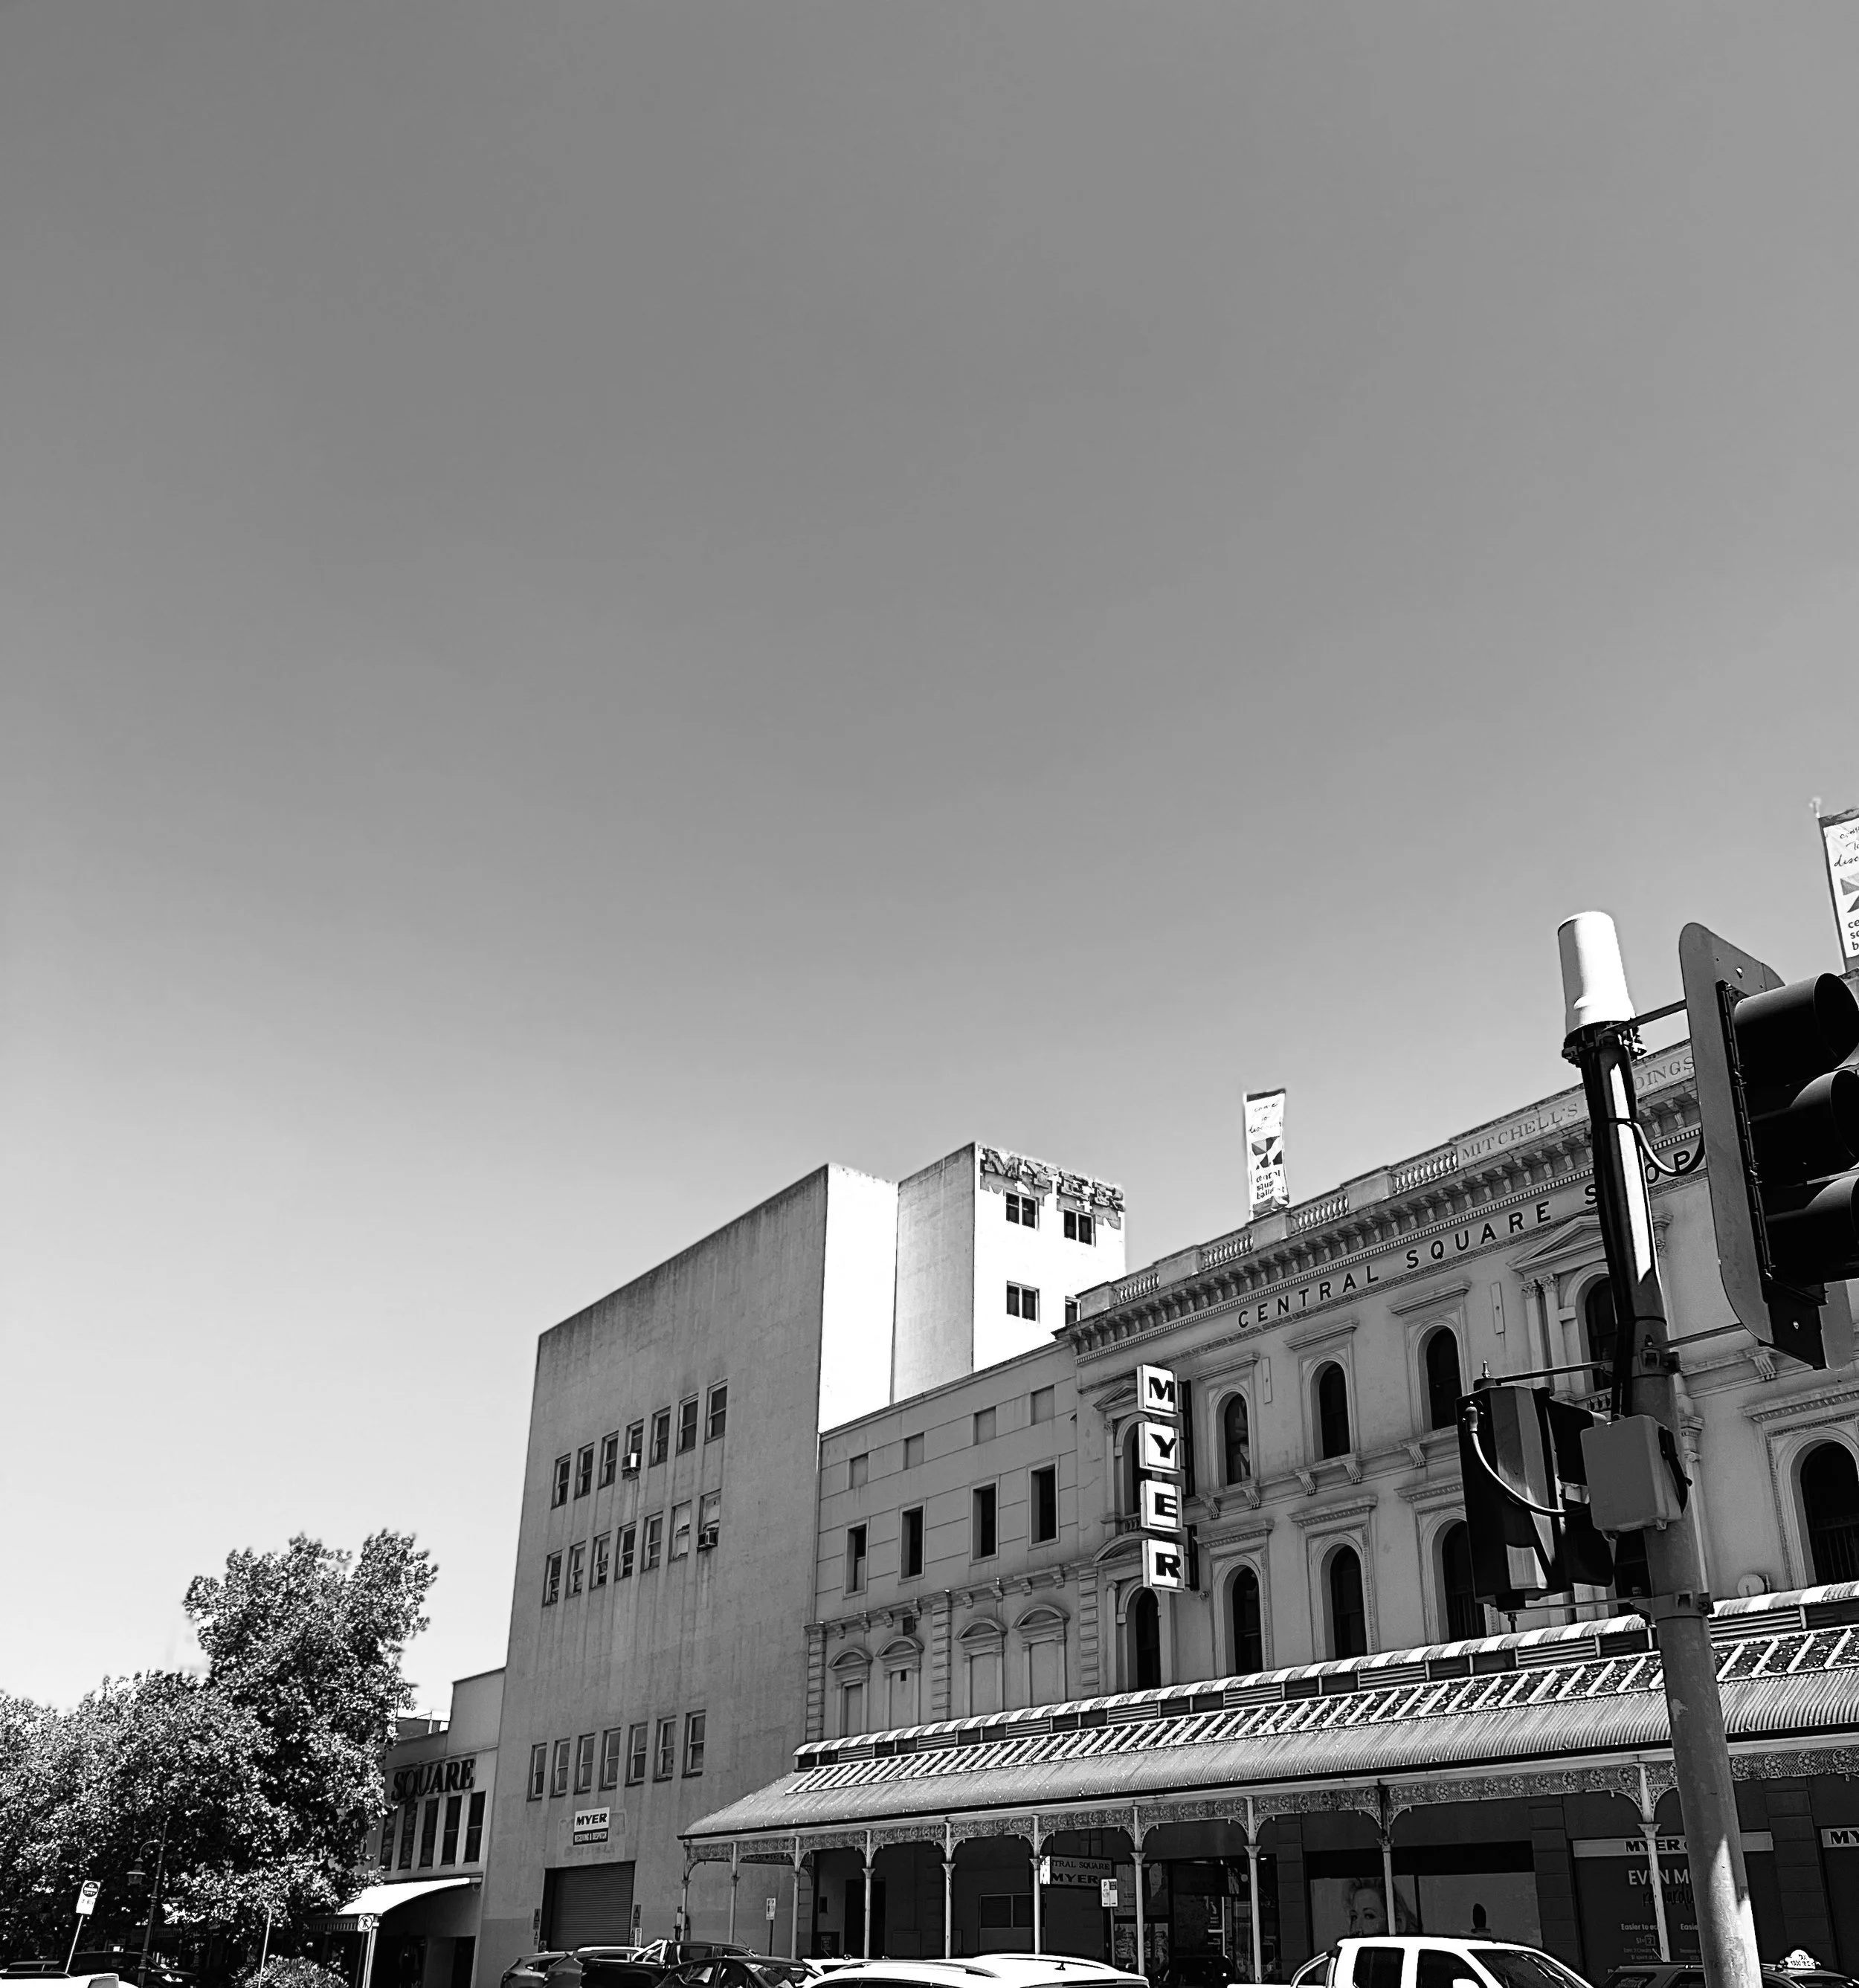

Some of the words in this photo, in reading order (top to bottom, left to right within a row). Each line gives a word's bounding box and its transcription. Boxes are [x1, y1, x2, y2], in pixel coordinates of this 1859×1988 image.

[1461, 1102, 1579, 1161] MITCHELL'S
[1634, 1056, 1694, 1091] DINGS
[1237, 1265, 1379, 1329] CENTRAL
[1405, 1200, 1551, 1270] SQUARE
[1584, 1149, 1690, 1206] SOP
[1148, 1376, 1182, 1579] MYER
[390, 1758, 475, 1803] SQUARE
[576, 1813, 608, 1826] MYER
[1078, 1861, 1110, 1871] SQUARE
[1051, 1873, 1098, 1884] MYER
[1628, 1868, 1670, 1885] EVN
[1681, 1923, 1699, 1931] Easie
